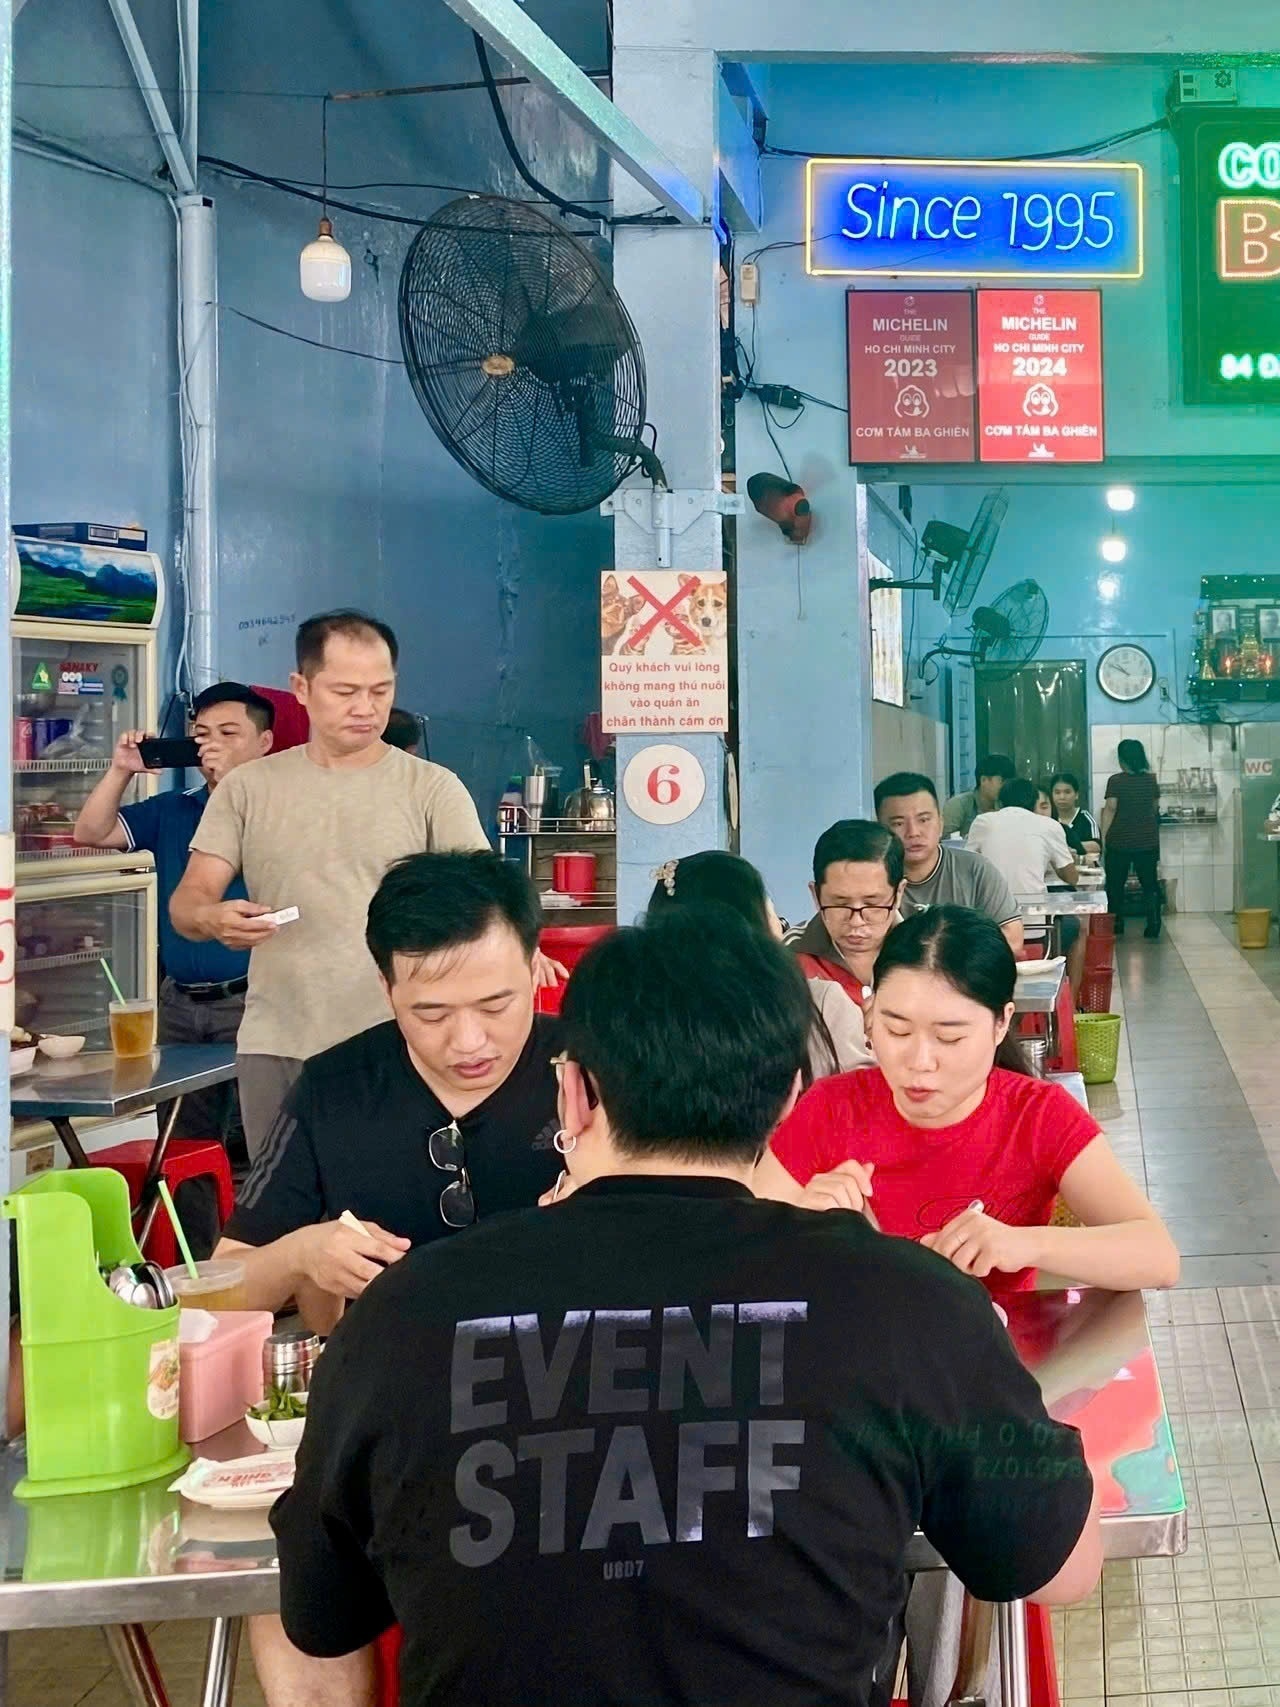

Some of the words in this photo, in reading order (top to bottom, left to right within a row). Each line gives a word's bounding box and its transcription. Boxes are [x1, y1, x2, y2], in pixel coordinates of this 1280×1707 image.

[842, 181, 981, 240] Since
[1002, 191, 1116, 251] 1995
[873, 318, 948, 331] MICHELIN
[1001, 316, 1077, 331] MICHELIN
[864, 345, 880, 354] HO
[883, 345, 901, 354] CHI
[903, 345, 930, 354] MINH
[933, 344, 956, 354] CITY
[993, 343, 1010, 353] HO
[1012, 343, 1030, 353] CHI
[1032, 343, 1059, 353] MINH
[1061, 343, 1085, 353] CITY
[884, 358, 938, 377] 2023
[1012, 356, 1067, 377] 2024
[914, 427, 931, 437] BA
[1042, 425, 1060, 436] BA
[636, 662, 671, 672] khách
[674, 662, 692, 672] vui
[695, 662, 720, 674] lòng
[604, 681, 640, 693] không
[643, 683, 675, 693] mang
[679, 681, 697, 690] thú
[701, 681, 725, 690] nuôi
[630, 697, 651, 707] vào
[654, 697, 682, 709] quán
[606, 716, 636, 727] chân
[640, 715, 675, 726] thành
[1246, 761, 1272, 773] WC
[647, 764, 681, 805] 6
[450, 1301, 808, 1434] EVENT
[449, 1420, 806, 1568] STAFF
